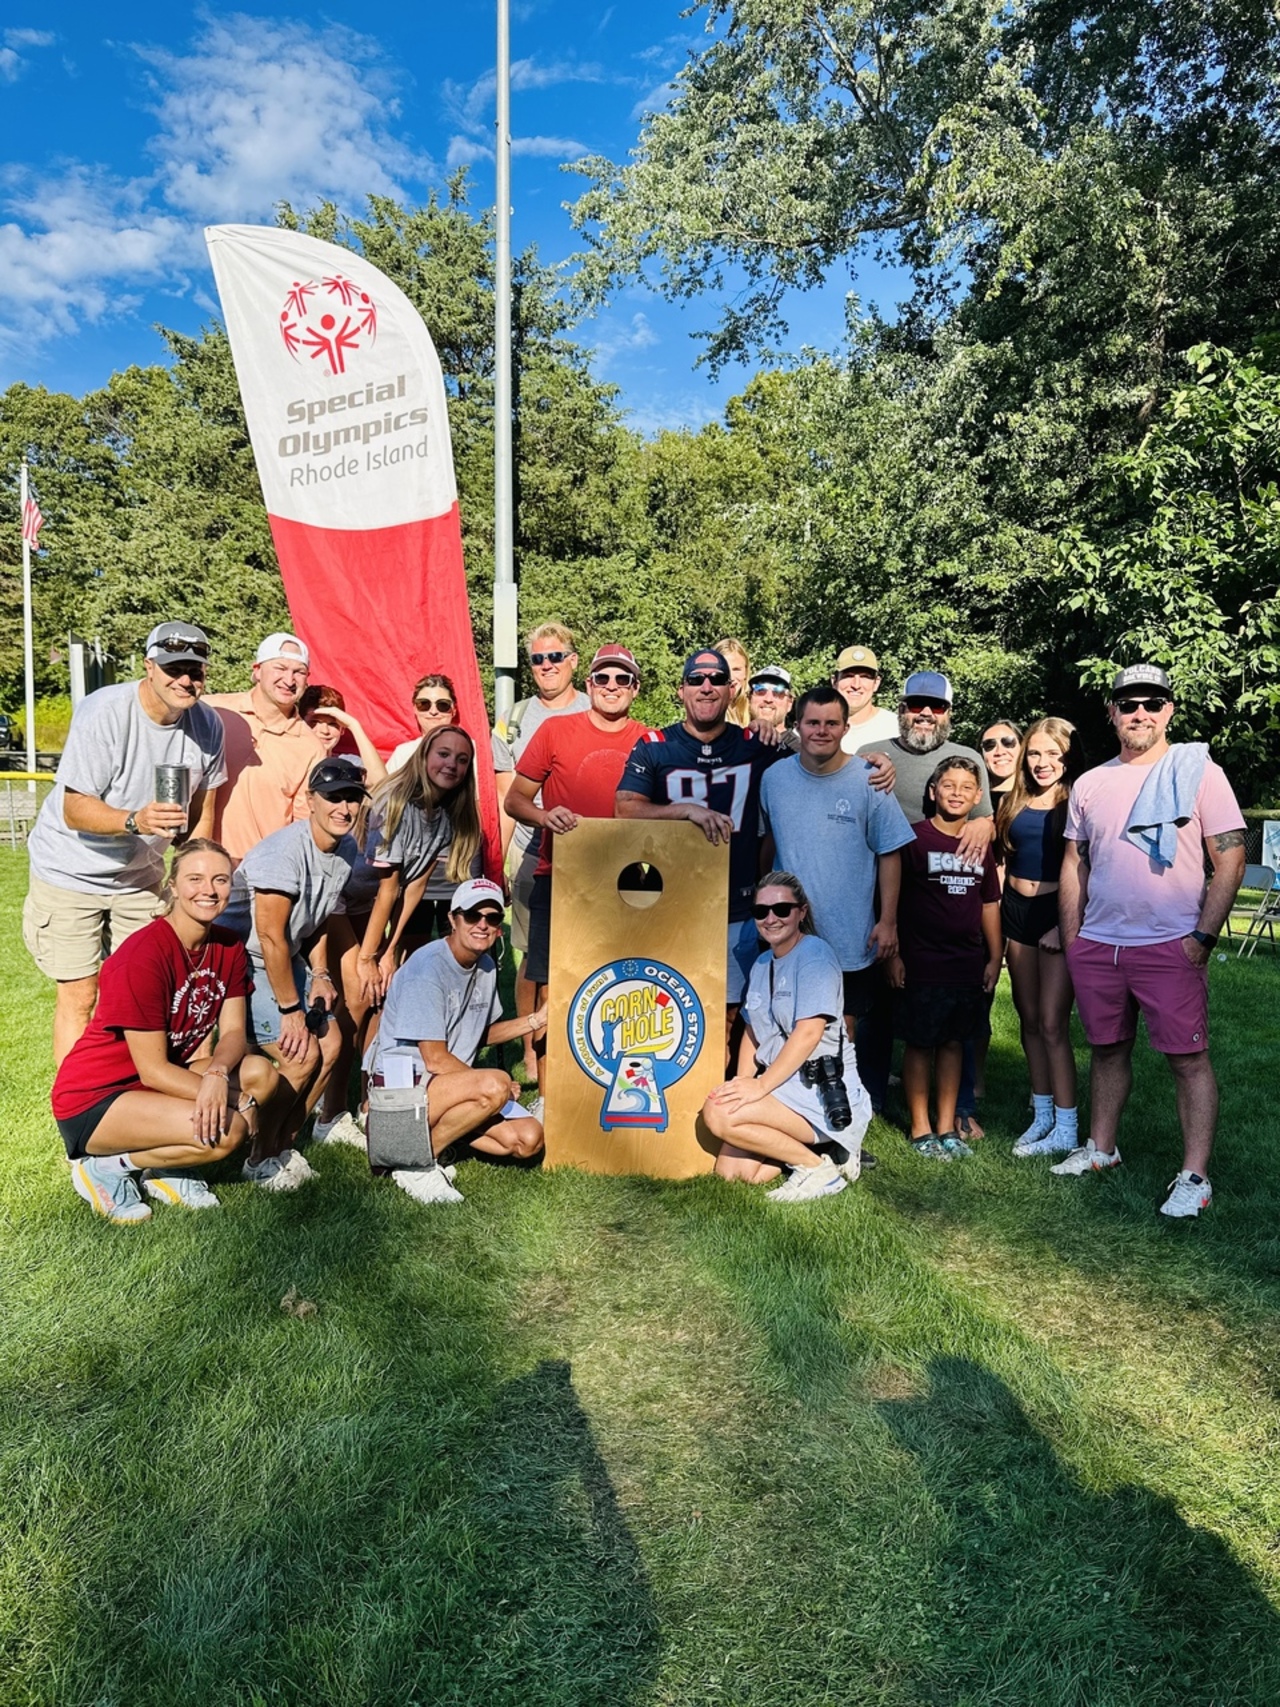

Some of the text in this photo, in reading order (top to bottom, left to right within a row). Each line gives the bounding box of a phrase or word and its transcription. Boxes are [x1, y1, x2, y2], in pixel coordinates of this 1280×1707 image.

[287, 374, 406, 425] Special
[278, 407, 428, 458] Olympics
[290, 435, 428, 487] Rhode Island
[666, 763, 752, 833] 87
[601, 984, 657, 1022] CORN
[621, 1007, 674, 1049] HOLE
[644, 966, 698, 1068] OCEAN STATE
